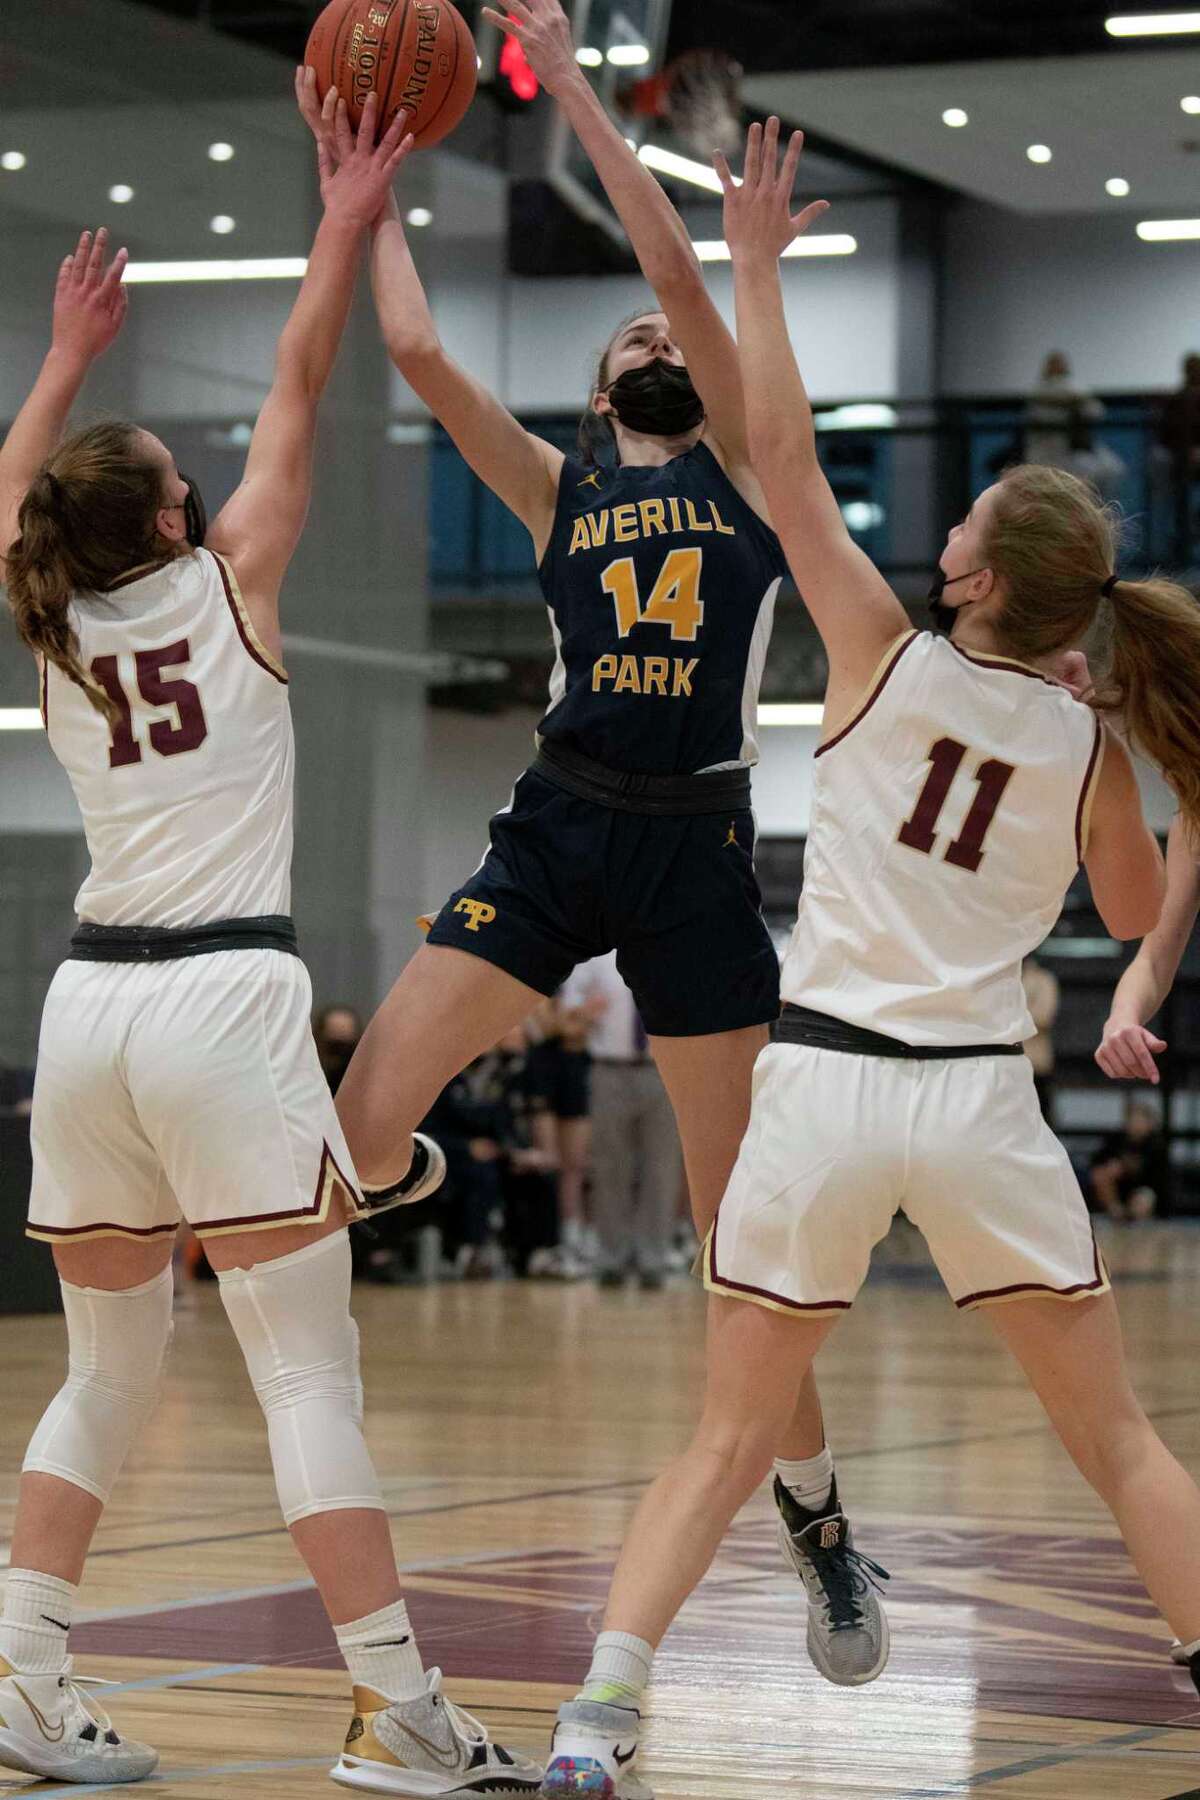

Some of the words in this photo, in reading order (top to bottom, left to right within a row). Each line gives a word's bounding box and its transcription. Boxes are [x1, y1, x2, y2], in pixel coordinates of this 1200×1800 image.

[390, 0, 440, 119] SPALDING
[568, 497, 735, 556] AVERILL
[600, 547, 704, 641] 14
[90, 638, 208, 768] 15
[591, 653, 700, 697] PARK
[897, 737, 1016, 873] 11
